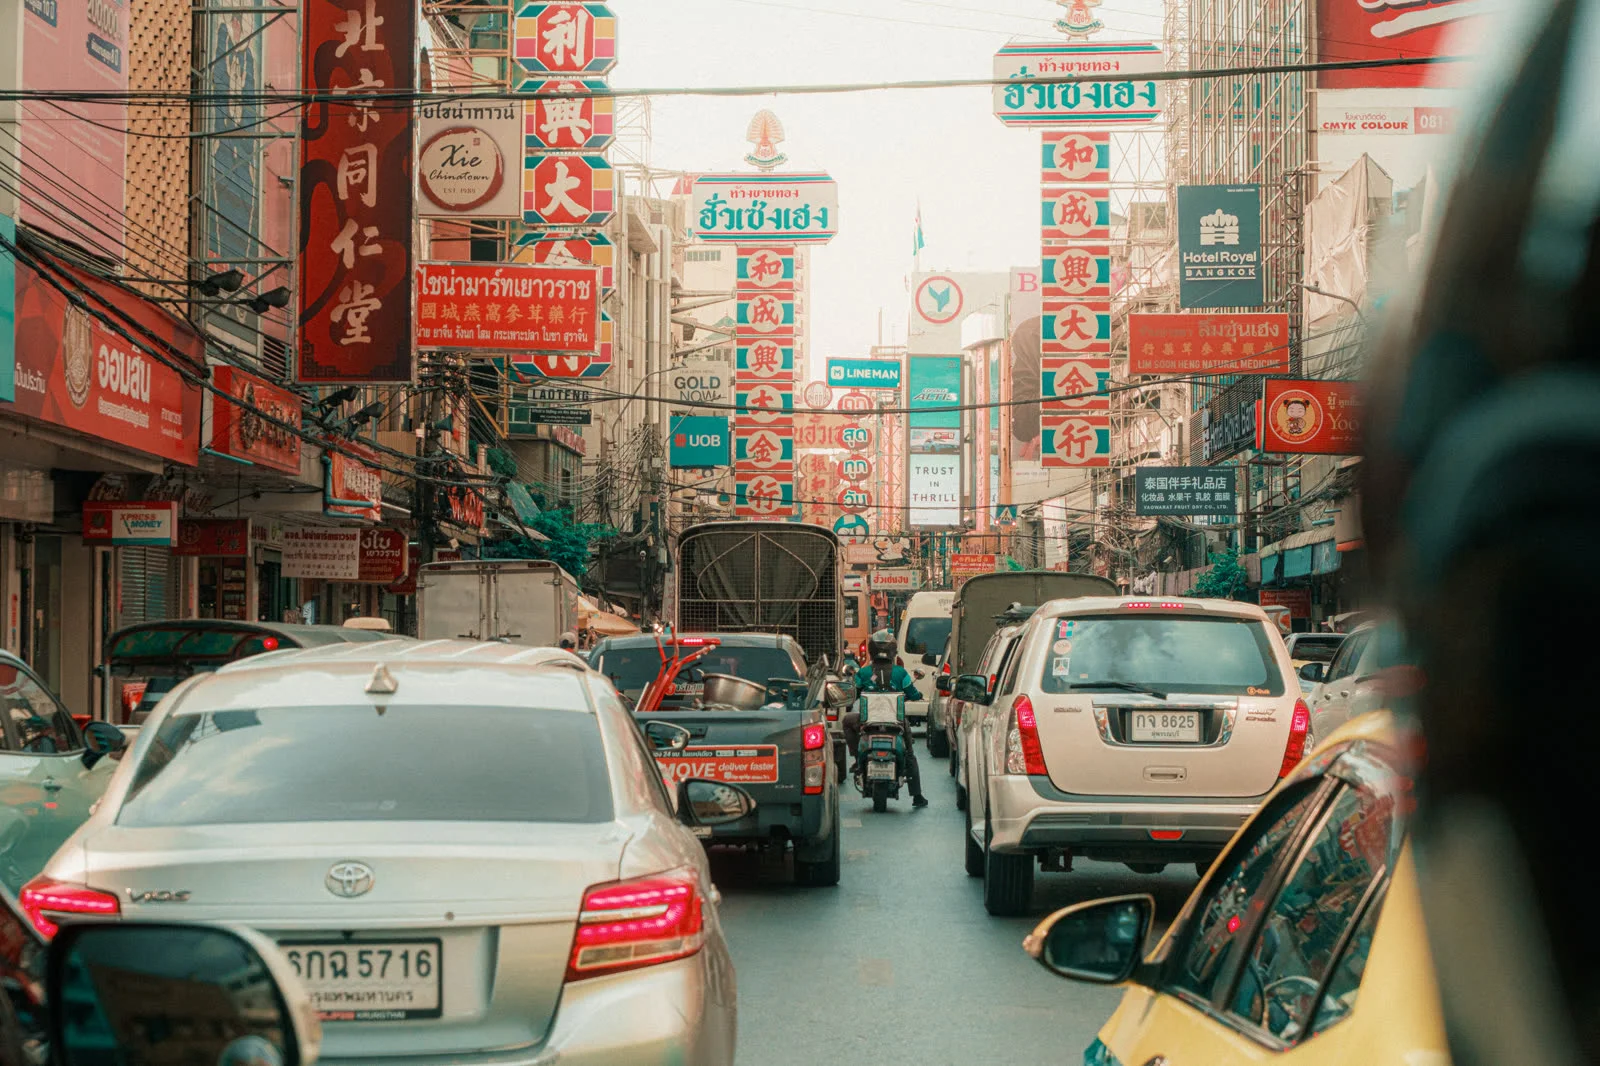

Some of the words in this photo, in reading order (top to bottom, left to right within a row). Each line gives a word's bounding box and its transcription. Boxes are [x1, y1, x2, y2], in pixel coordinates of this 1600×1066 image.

[1038, 58, 1120, 73] ห้างขายทอง
[1322, 121, 1356, 130] CMYK
[1360, 121, 1409, 130] COLOUR
[439, 144, 482, 167] Xie
[331, 0, 384, 346] 北京同仁堂
[429, 169, 489, 181] Chinatown
[540, 8, 591, 371] 利興大
[730, 186, 799, 198] ห้างขายทอง
[699, 192, 829, 231] ฮั่วเซ่งเฮง
[1183, 251, 1219, 263] Hotel
[1220, 251, 1257, 265] Royal
[1185, 268, 1256, 277] BANGKOK
[417, 266, 591, 300] ไชน่ามาร์ทเยาวราช
[1056, 139, 1094, 458] 和成興大金行
[1137, 359, 1152, 369] LIM
[1154, 359, 1176, 369] SOON
[1178, 359, 1200, 369] HENG
[1202, 359, 1239, 369] NATURAL
[1240, 359, 1281, 369] MEDICINE
[847, 368, 872, 379] LINE
[872, 369, 898, 380] MAN
[674, 376, 721, 390] GOLD
[748, 253, 782, 511] 和成興大金行
[680, 390, 716, 402] NOW
[913, 393, 957, 402] ALTIS
[689, 434, 721, 447] UOB
[915, 466, 955, 475] TRUST
[1144, 476, 1227, 490] 泰国伴手礼品店
[913, 493, 957, 503] THRILL
[1141, 492, 1165, 502] 化妆品
[1167, 492, 1192, 502] 水果干
[119, 513, 157, 521] XPRESS
[130, 520, 163, 528] MONEY
[1136, 714, 1156, 729] กจ
[1161, 714, 1195, 729] 8625
[718, 762, 748, 772] deliver
[749, 761, 774, 771] faster
[357, 949, 432, 979] 5716
